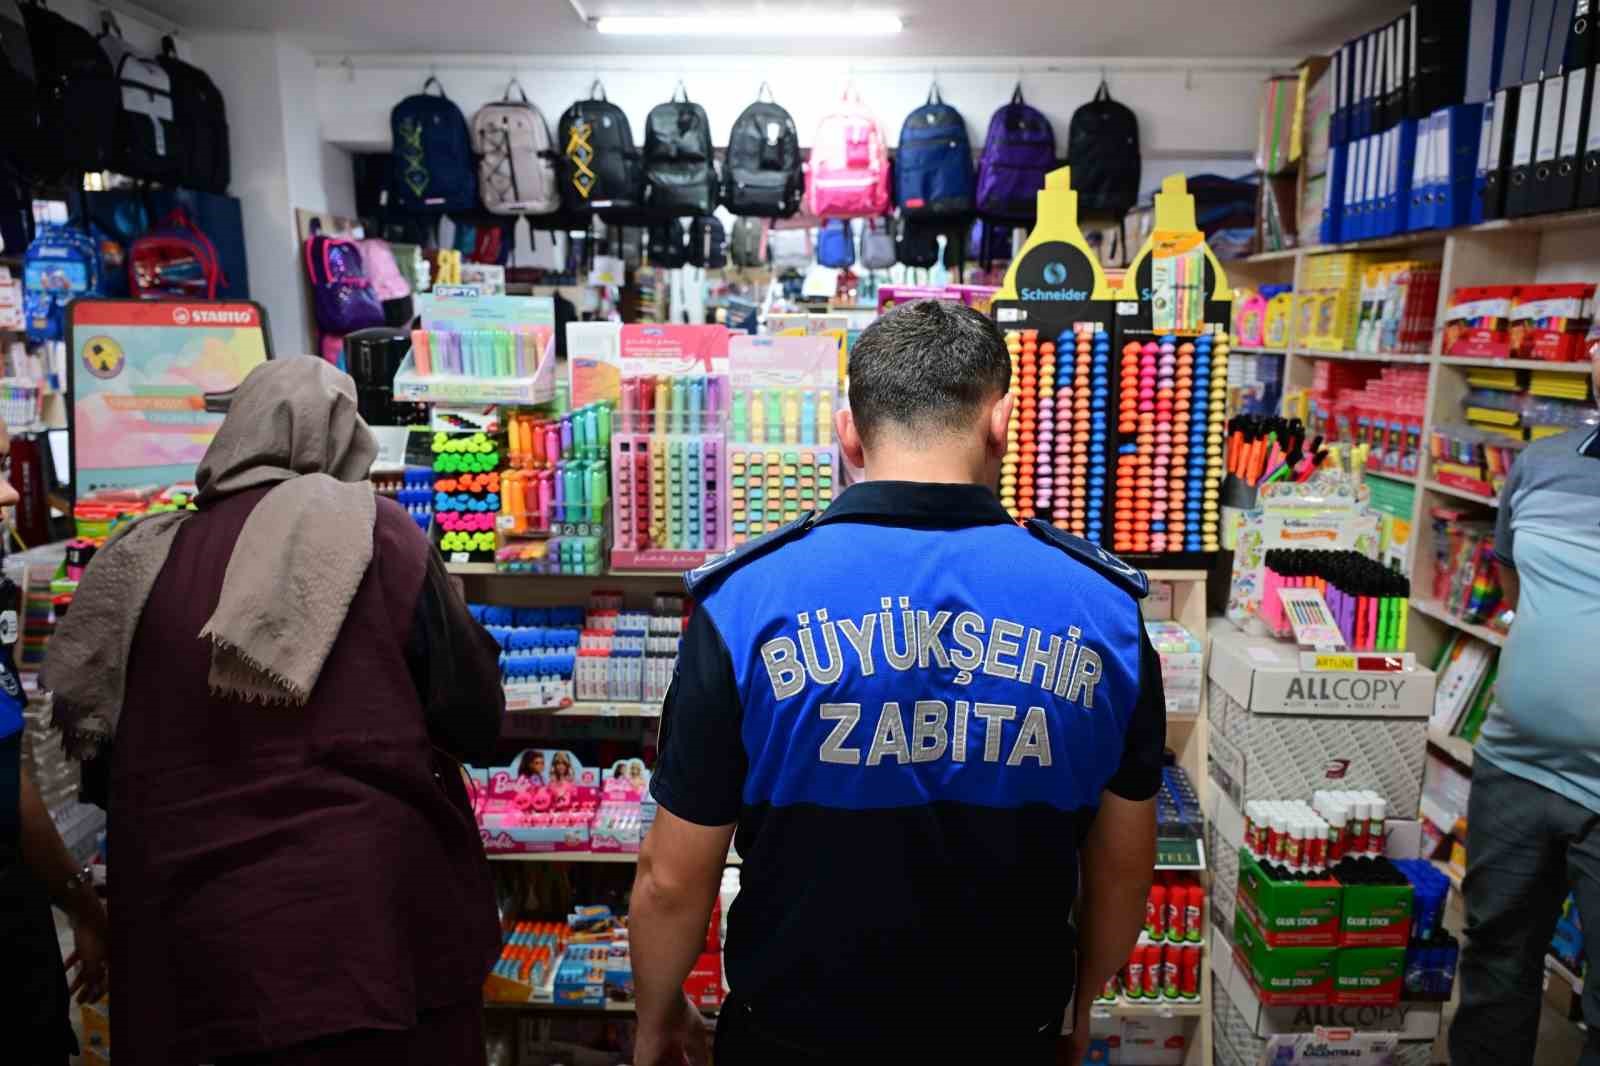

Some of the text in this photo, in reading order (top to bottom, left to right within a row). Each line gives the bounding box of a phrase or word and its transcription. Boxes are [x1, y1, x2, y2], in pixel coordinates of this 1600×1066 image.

[1021, 287, 1087, 300] Schneider
[191, 310, 251, 323] STABILO
[760, 595, 1103, 709] BÜYÜKŞEHİR
[1286, 677, 1405, 701] ALLCOPY
[819, 700, 1053, 768] ZABITA
[1275, 916, 1318, 926] GLUE STICK
[1346, 916, 1390, 927] GLUE STICK
[1270, 977, 1313, 987] GLUE STICK
[1338, 976, 1381, 986] GLUE STICK
